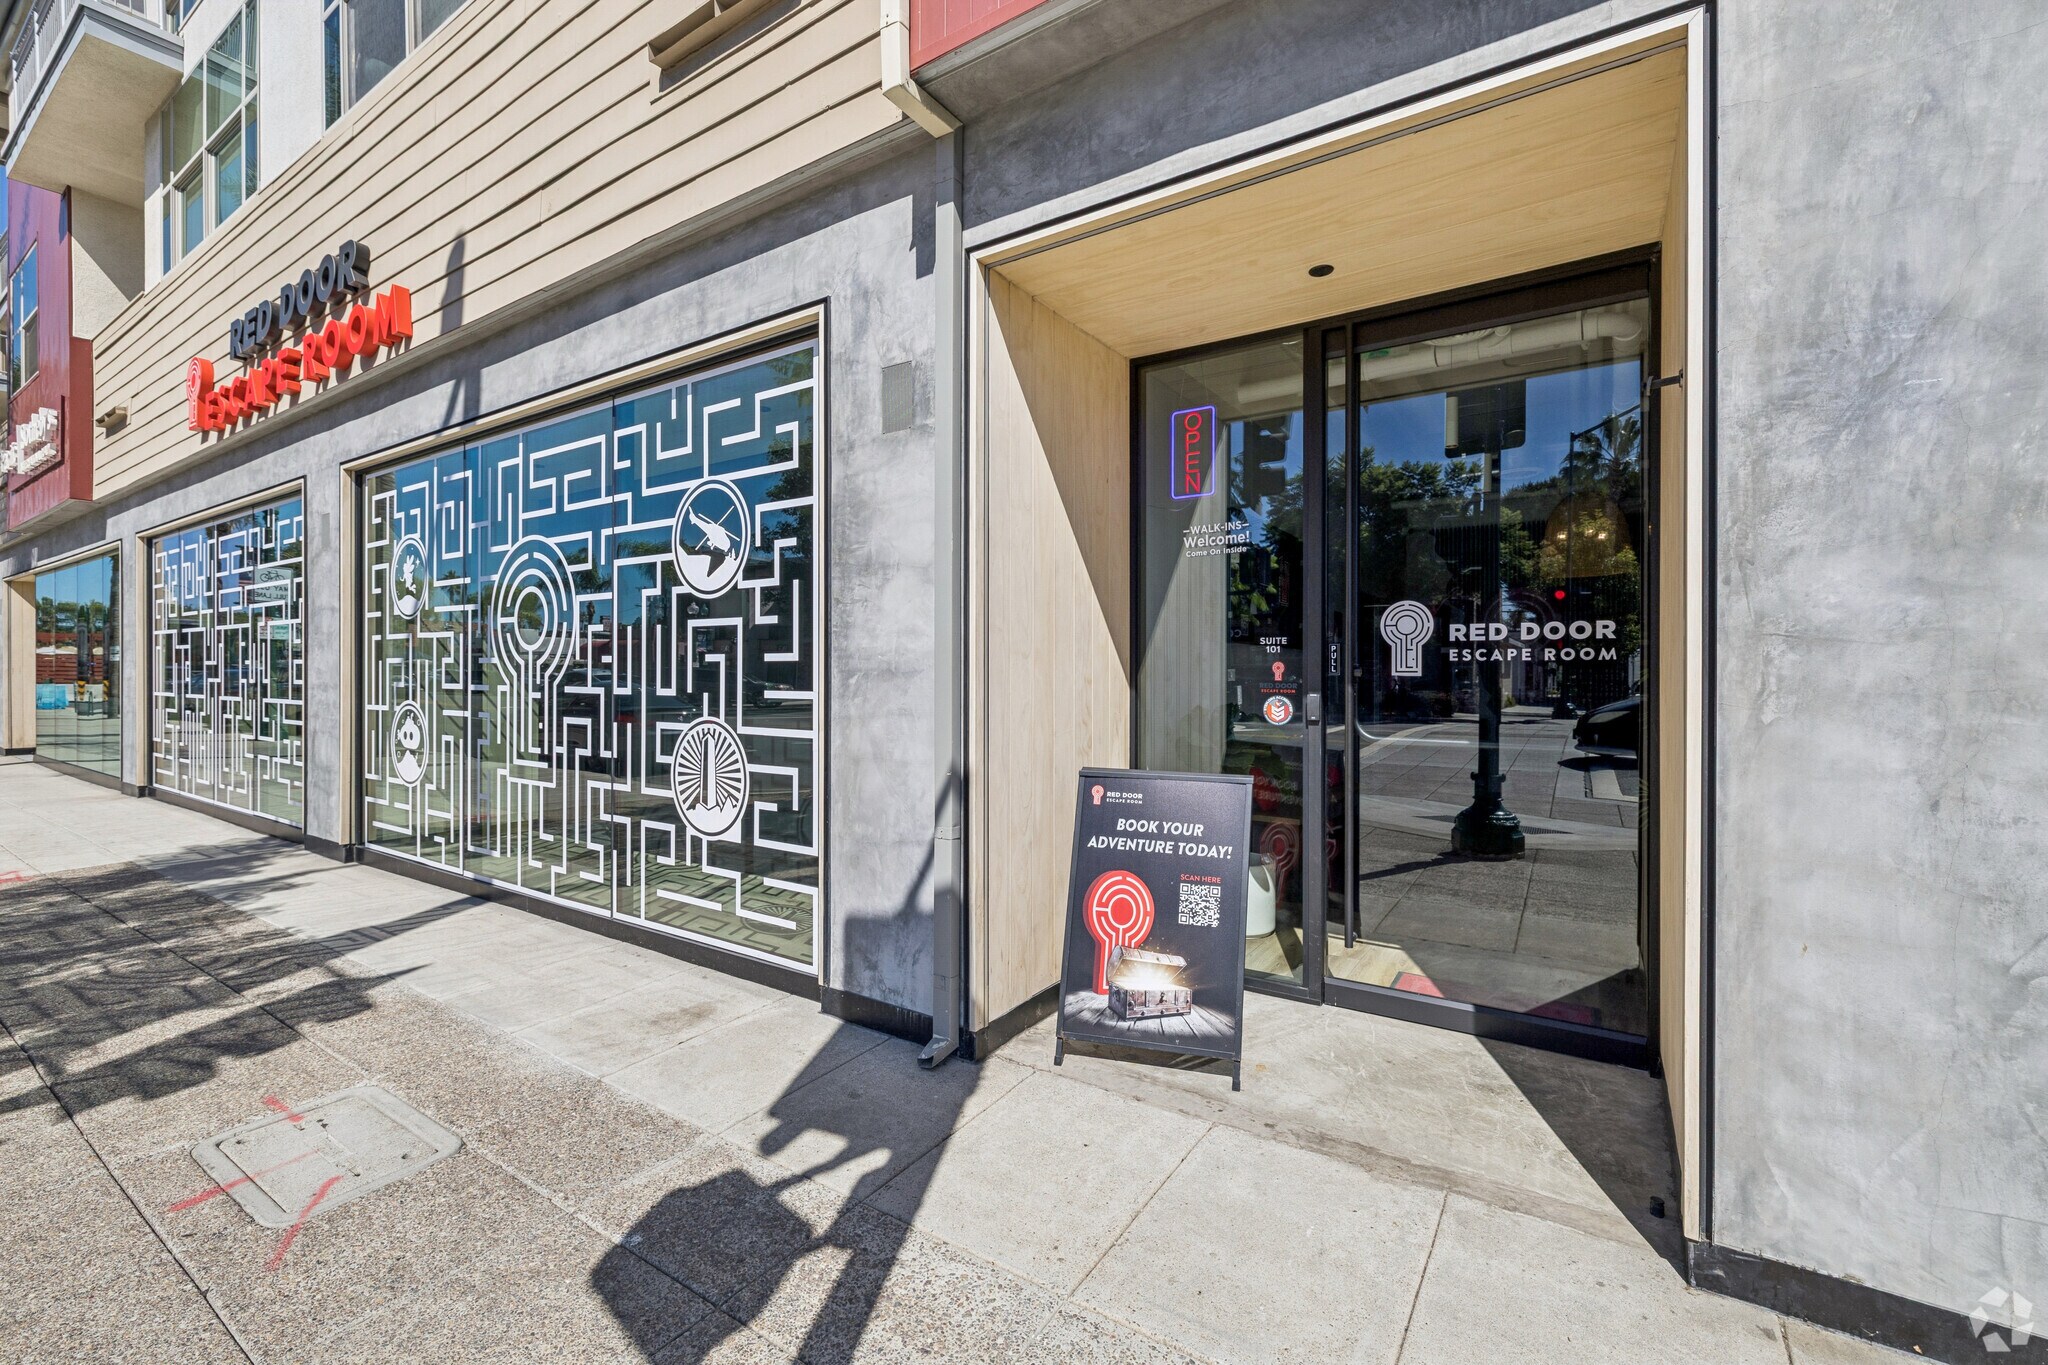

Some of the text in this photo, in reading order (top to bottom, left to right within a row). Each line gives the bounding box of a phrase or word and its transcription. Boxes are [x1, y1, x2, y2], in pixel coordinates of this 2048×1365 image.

[230, 239, 370, 361] RED DOOR
[204, 284, 413, 431] ESCAPE ROOM
[1184, 411, 1203, 494] OPEN
[1183, 532, 1250, 549] Welcome!
[1186, 550, 1207, 558] Come
[1223, 546, 1247, 554] Inside
[1450, 620, 1617, 642] RED DOOR
[1259, 637, 1288, 645] SUITE
[1450, 647, 1617, 662] ESCAPE ROOM
[1122, 791, 1143, 799] DOOR
[1116, 818, 1204, 837] BOOK YOUR
[1087, 836, 1233, 859] ADVENTURE TODAY!
[1180, 873, 1221, 884] SCAN HERE
